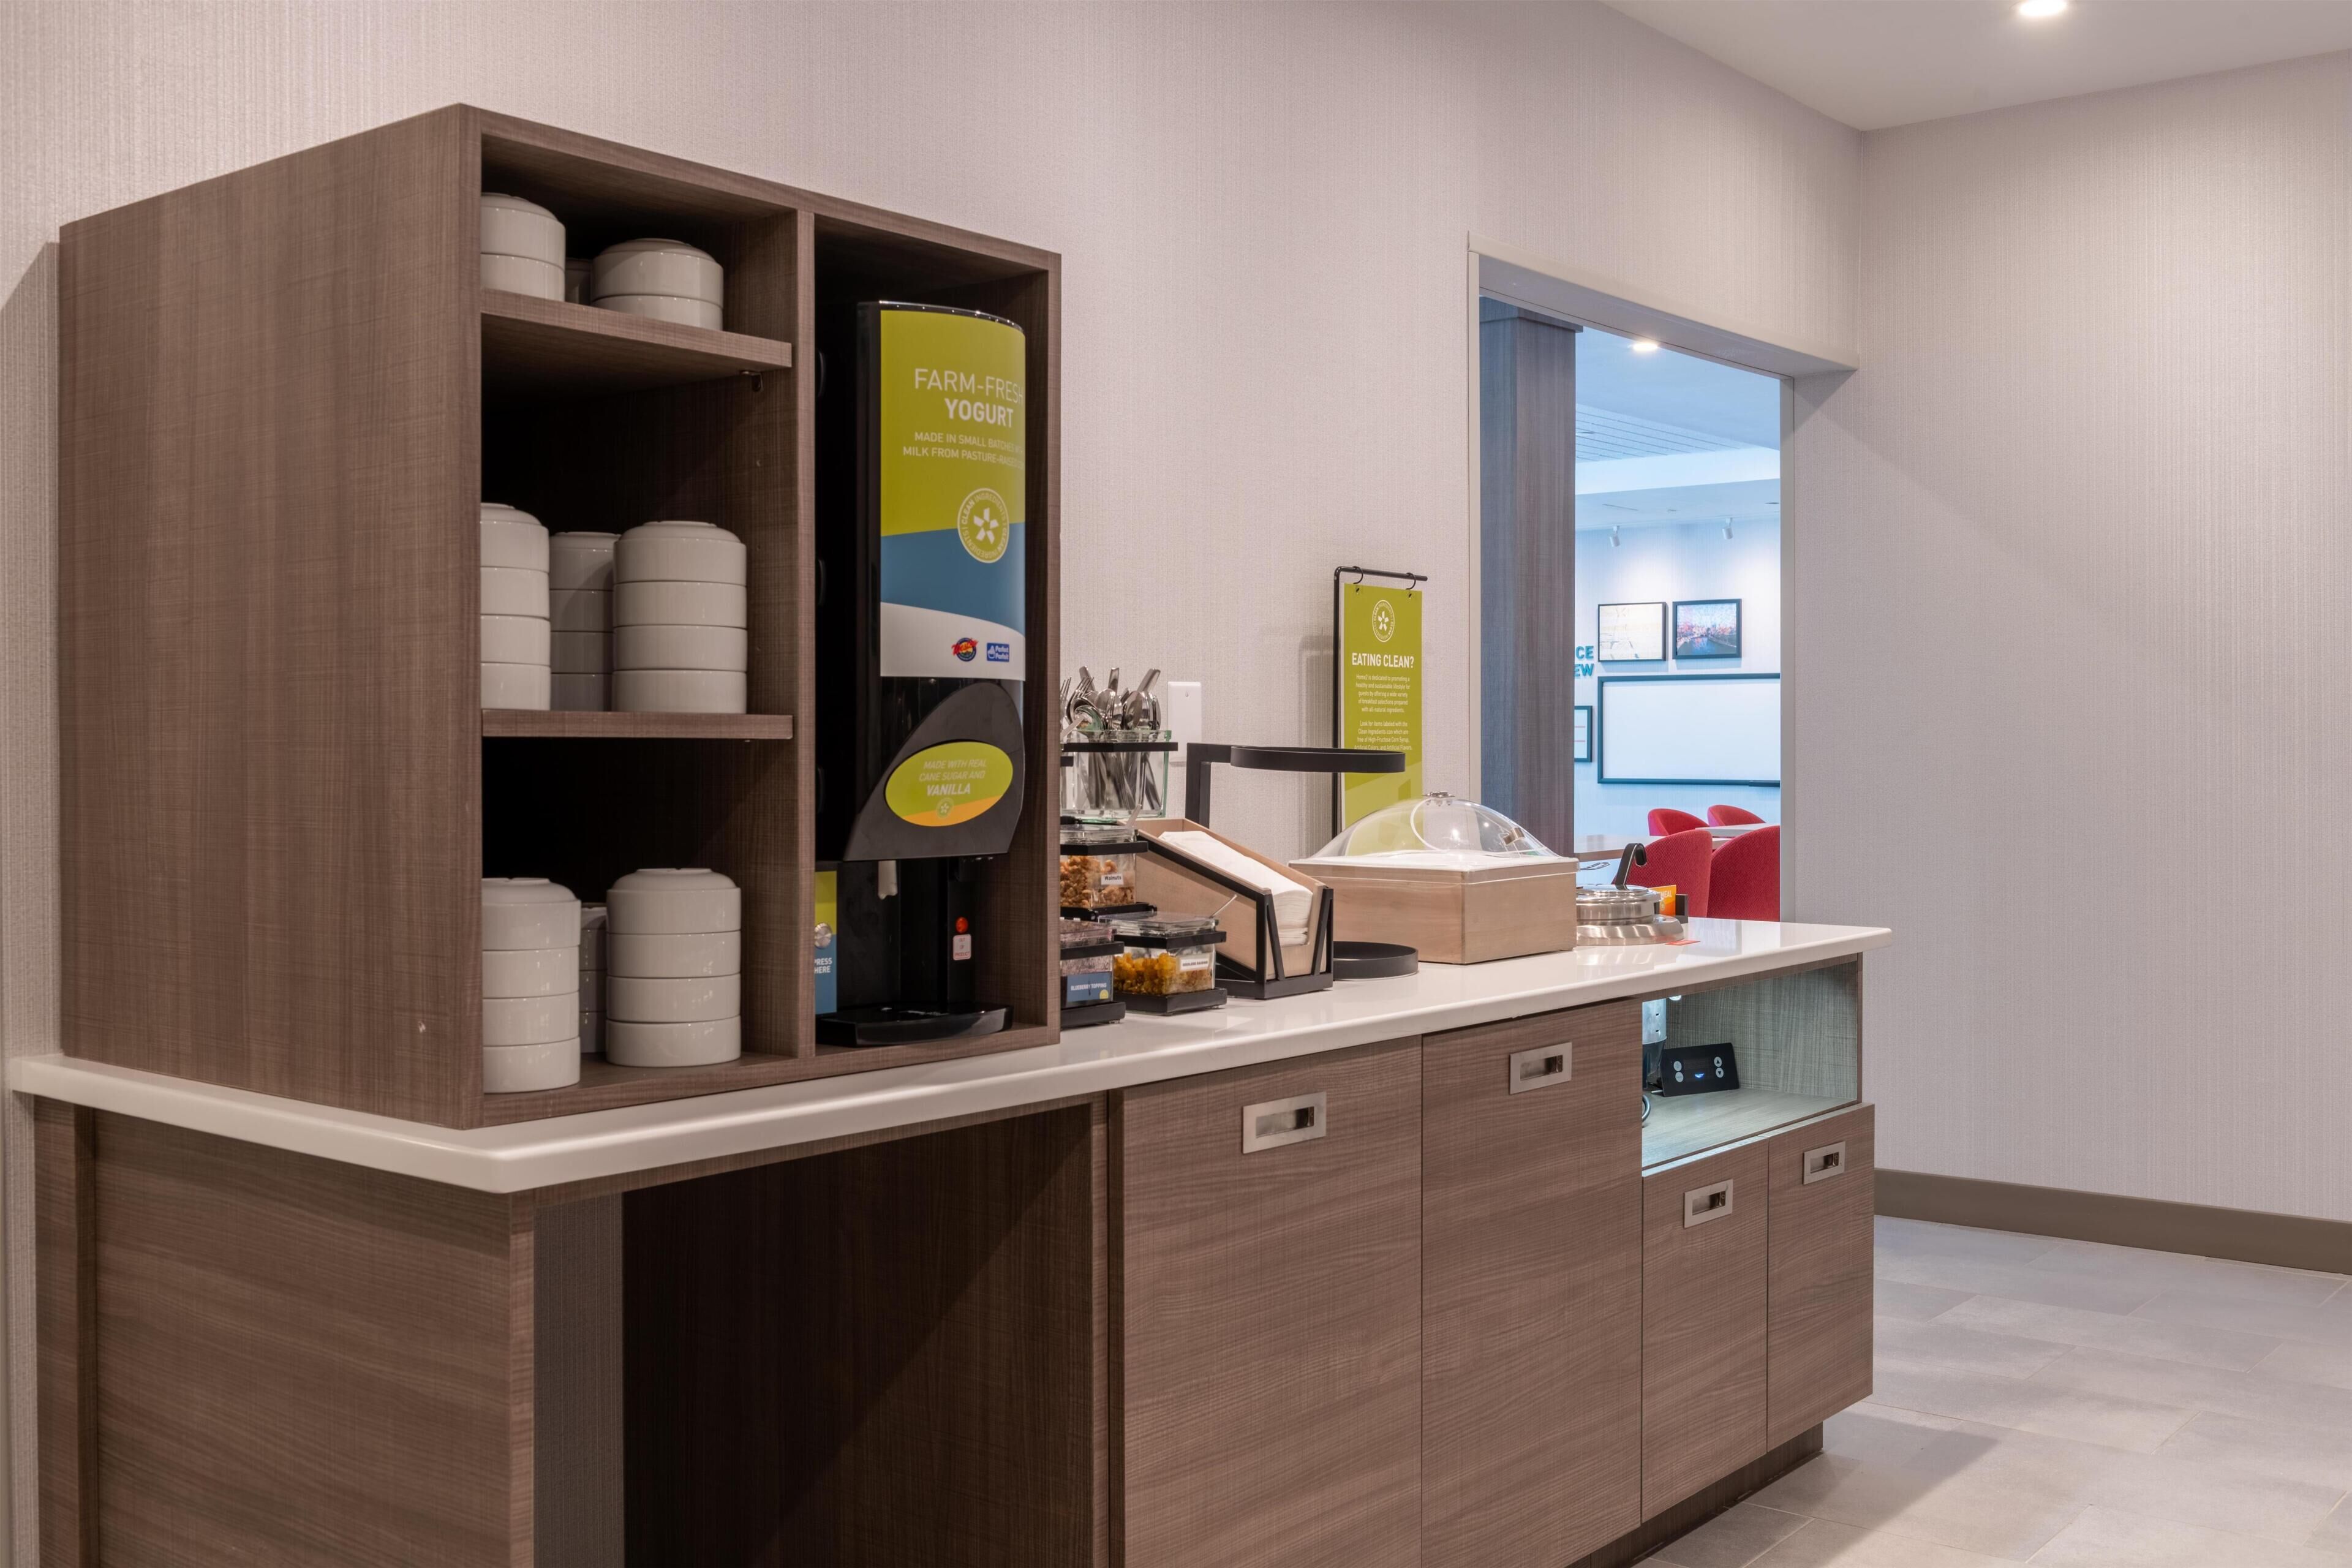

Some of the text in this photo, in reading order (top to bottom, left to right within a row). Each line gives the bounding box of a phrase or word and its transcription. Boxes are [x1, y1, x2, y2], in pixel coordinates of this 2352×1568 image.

[914, 368, 1023, 405] FARM-FRESH
[944, 398, 1014, 428] YOGURT
[914, 431, 943, 443] MADE
[946, 434, 956, 443] IN
[959, 434, 987, 448] SMALL
[903, 446, 929, 457] MILK
[931, 448, 959, 459] FROM
[961, 499, 975, 525] CLEAN
[1352, 652, 1414, 668] EATING CLEAN?
[923, 758, 987, 769] MADE WITH REAL
[919, 771, 986, 782] CANE SUGAR AND
[927, 783, 971, 796] VANILLA
[814, 965, 831, 974] HERE
